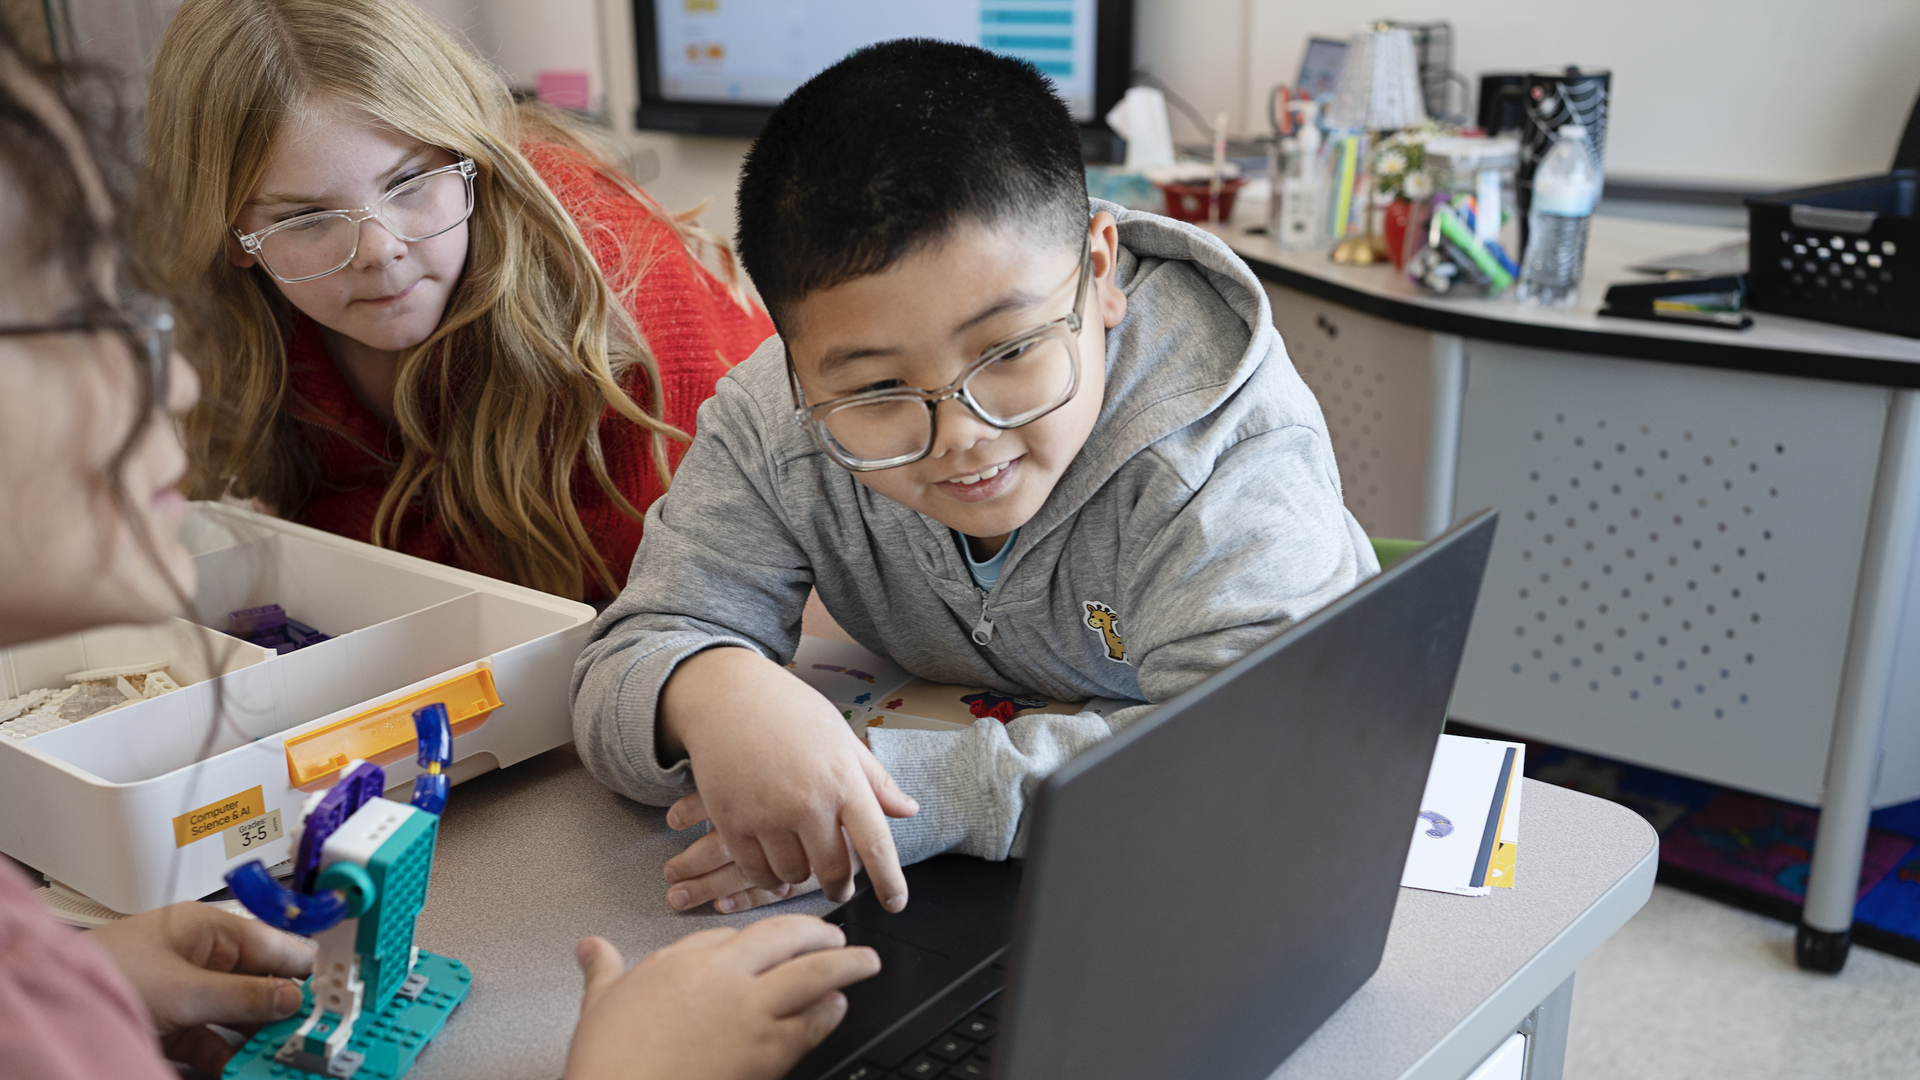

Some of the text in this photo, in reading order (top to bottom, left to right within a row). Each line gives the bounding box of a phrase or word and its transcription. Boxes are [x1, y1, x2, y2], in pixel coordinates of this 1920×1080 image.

[190, 800, 239, 825] Computer
[191, 805, 250, 836] Science & AI
[239, 818, 267, 834] Grades:
[241, 826, 267, 847] 3-5
